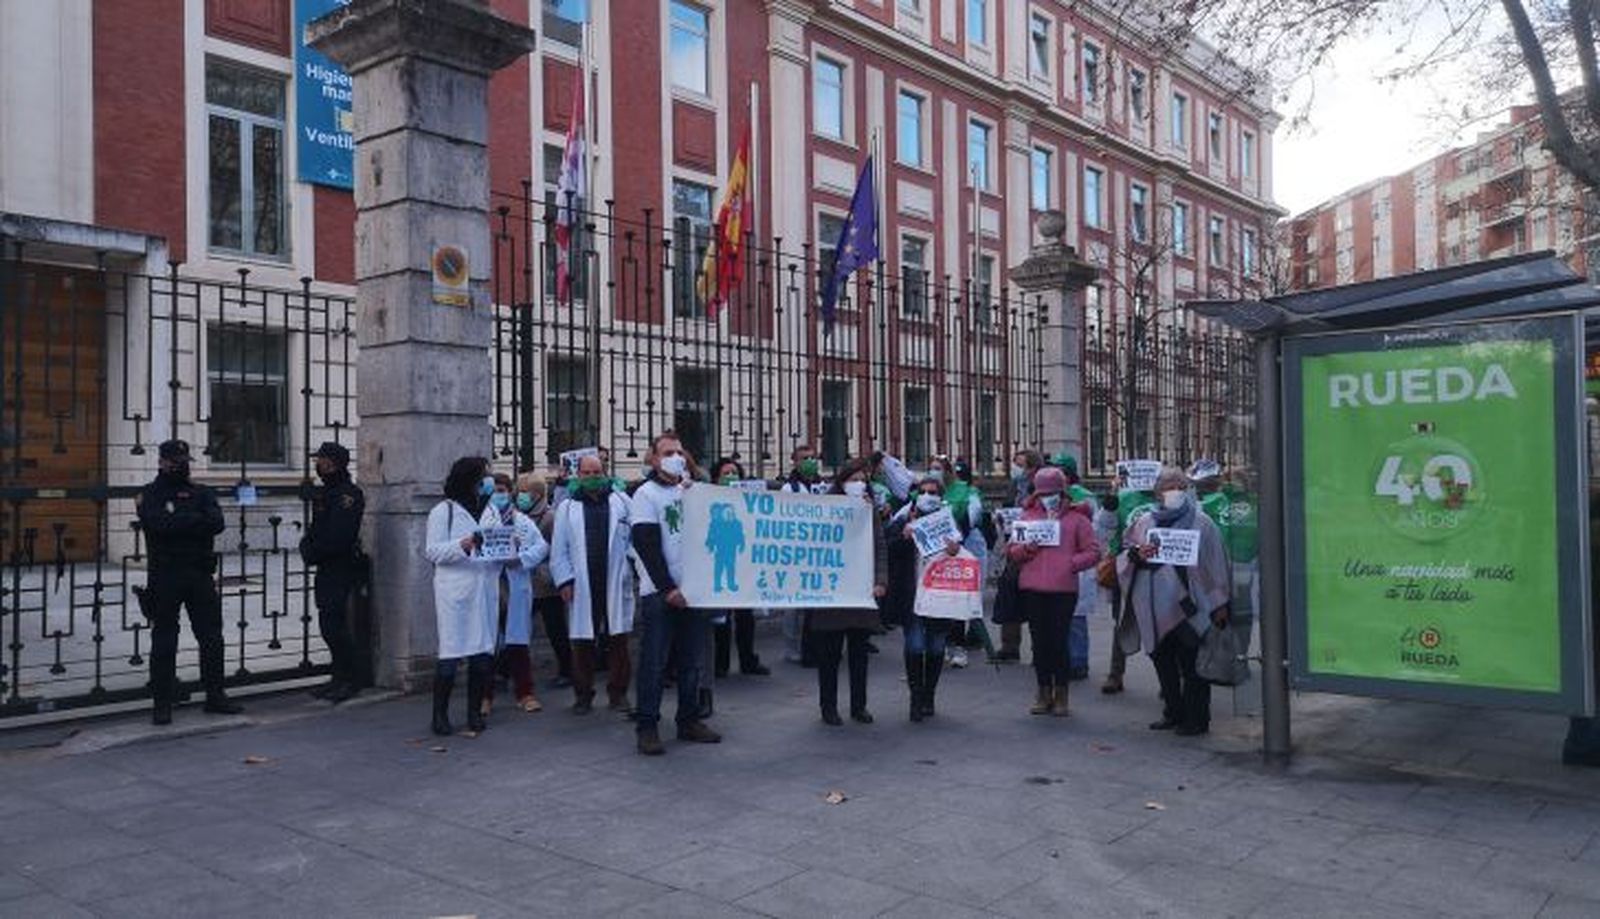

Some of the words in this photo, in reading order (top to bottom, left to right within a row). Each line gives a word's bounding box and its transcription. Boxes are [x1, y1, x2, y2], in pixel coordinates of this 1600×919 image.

[1328, 363, 1518, 408] RUEDA
[1375, 455, 1472, 505] 40
[743, 492, 775, 516] YO
[779, 503, 823, 518] LUCHO
[830, 506, 854, 521] POR
[756, 519, 844, 543] NUESTRO
[751, 543, 845, 568] HOSPITAL
[1400, 650, 1460, 667] RUEDA
